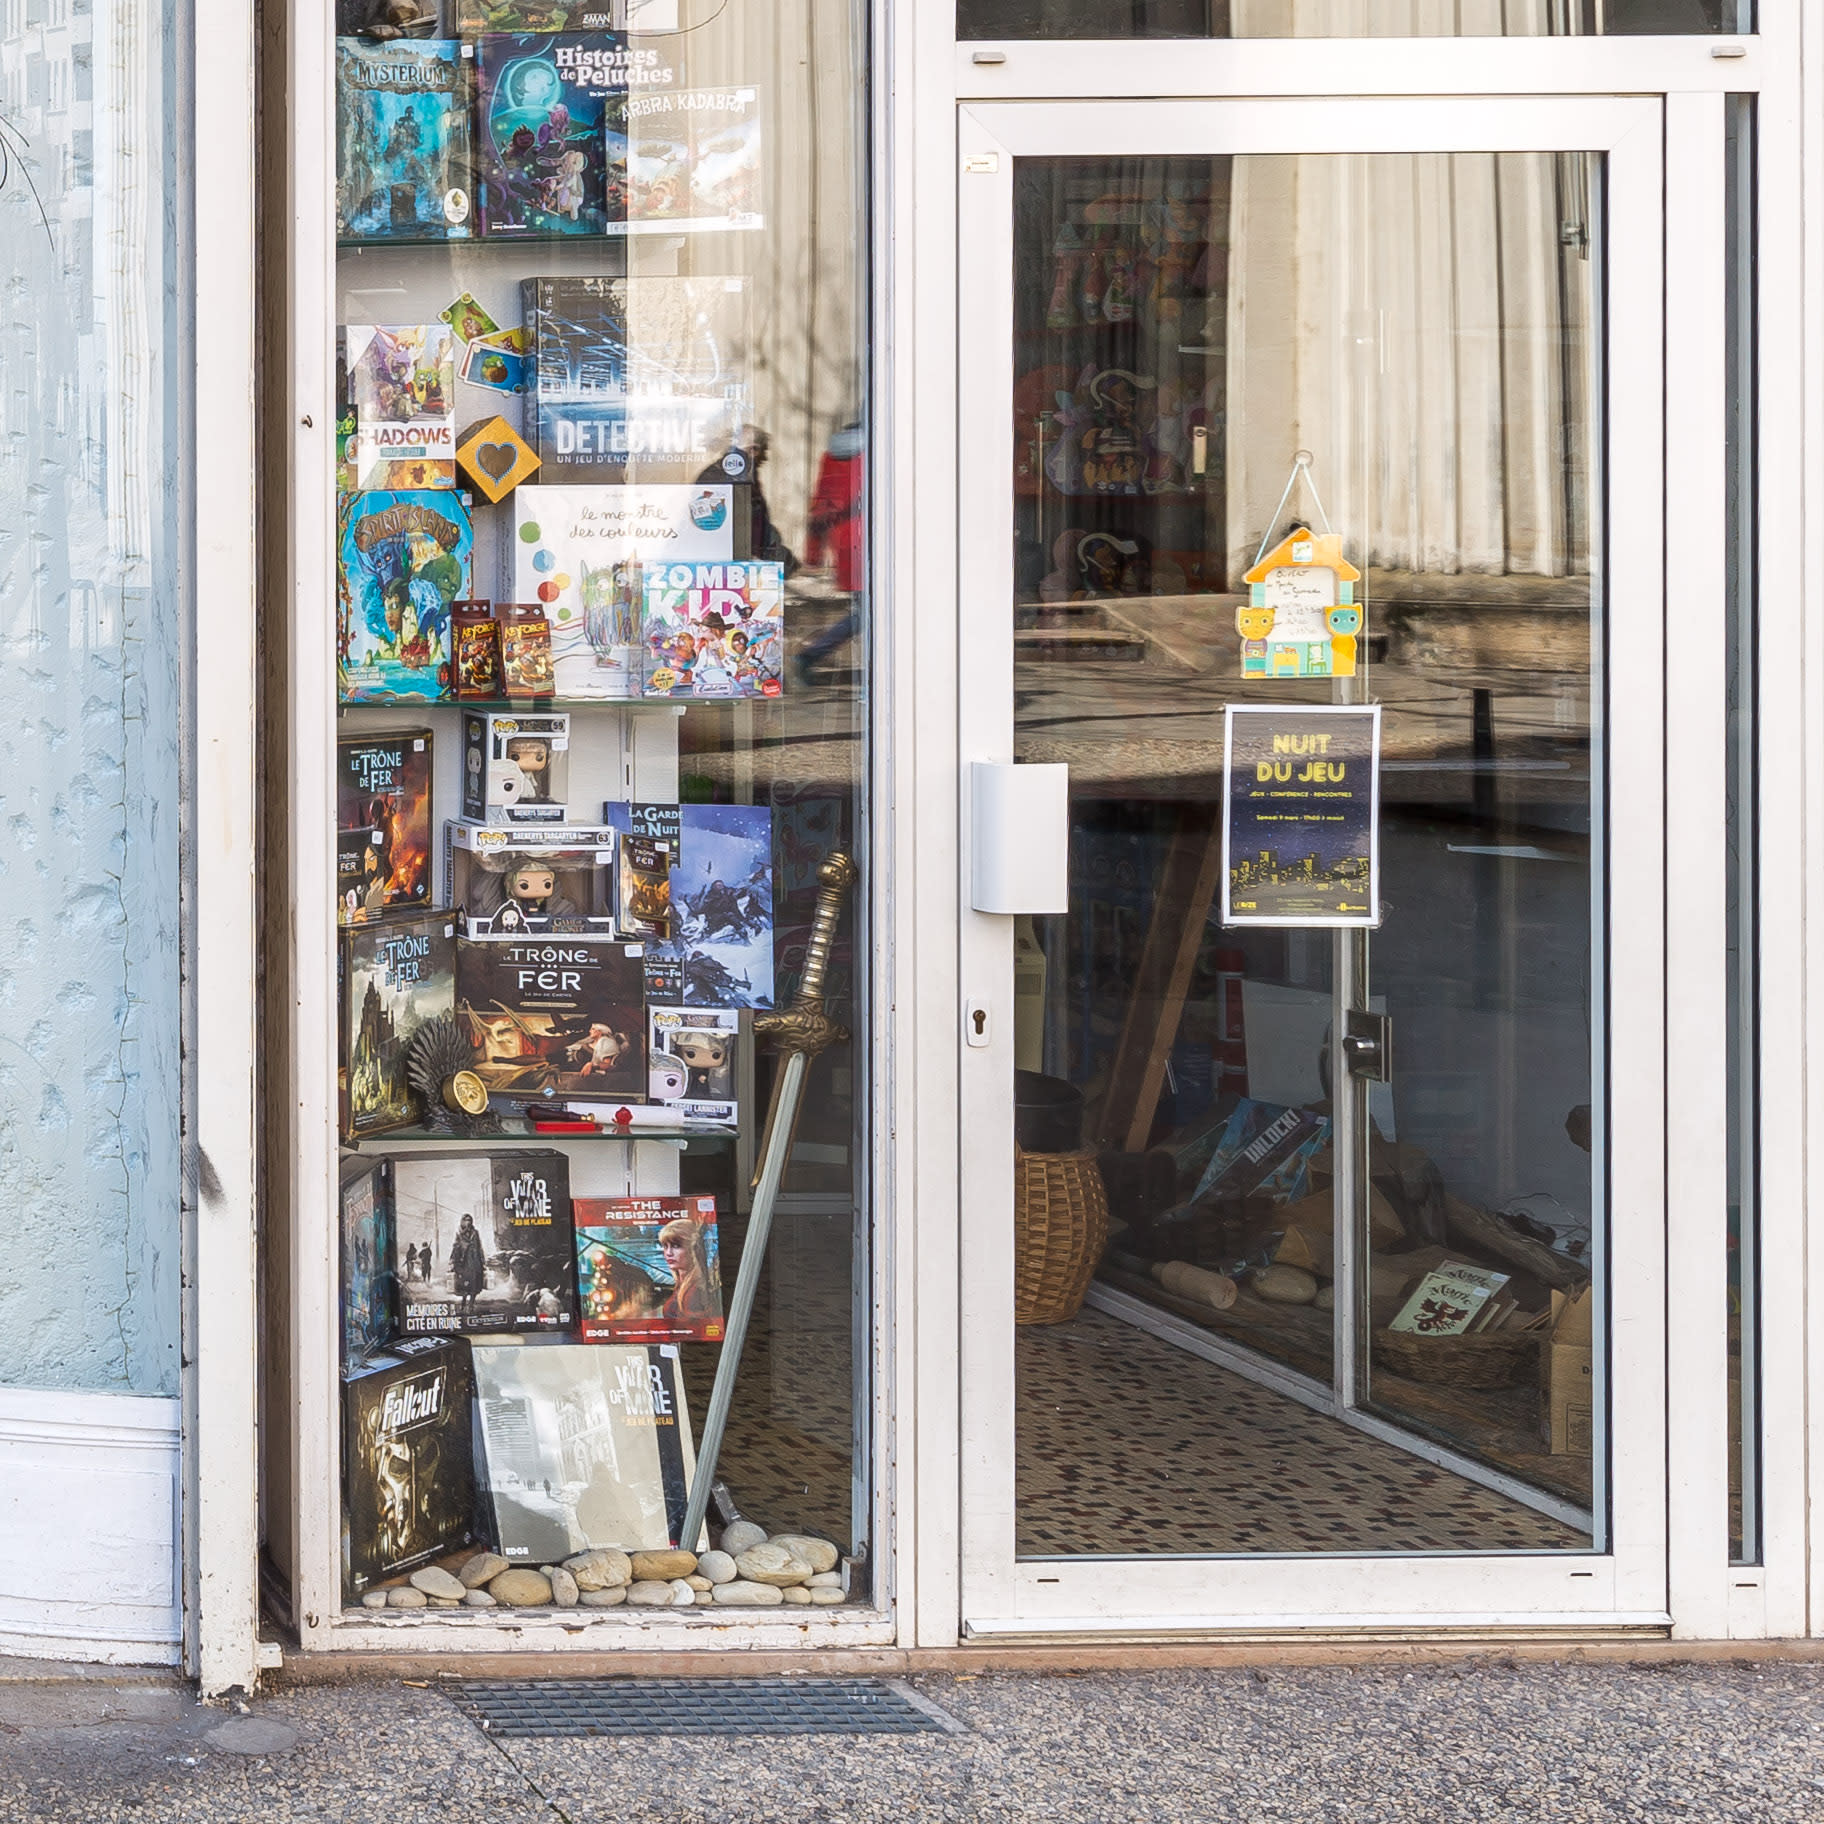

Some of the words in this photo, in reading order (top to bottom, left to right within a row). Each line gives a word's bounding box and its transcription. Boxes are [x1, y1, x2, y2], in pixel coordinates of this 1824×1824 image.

[554, 45, 657, 68] Histoires
[356, 61, 446, 88] MYSTERIUM
[560, 67, 576, 81] de
[576, 65, 673, 87] Peluches
[556, 420, 707, 454] DETECTIVE
[647, 565, 779, 589] ZOMBIE
[649, 589, 779, 626] KIDZ
[1272, 734, 1331, 754] NUIT
[350, 760, 360, 771] LE
[360, 750, 403, 776] TRÔNE
[1256, 761, 1291, 782] DU
[1298, 761, 1346, 782] JEU
[359, 777, 369, 788] DE
[371, 768, 394, 793] FER
[643, 806, 684, 822] GARDE
[647, 822, 681, 837] NUIT
[386, 934, 430, 972] TRÔNE
[510, 945, 588, 962] TRÔNE
[396, 961, 420, 993] FER
[517, 971, 582, 992] FER
[1244, 1107, 1302, 1164] UNLOCK!
[605, 1209, 689, 1220] RESISTANCE
[630, 1201, 662, 1210] THE
[406, 1317, 426, 1331] CITÉ
[586, 1329, 610, 1337] EDGE
[381, 1376, 440, 1432] Fallout
[505, 1547, 529, 1556] EDGE
